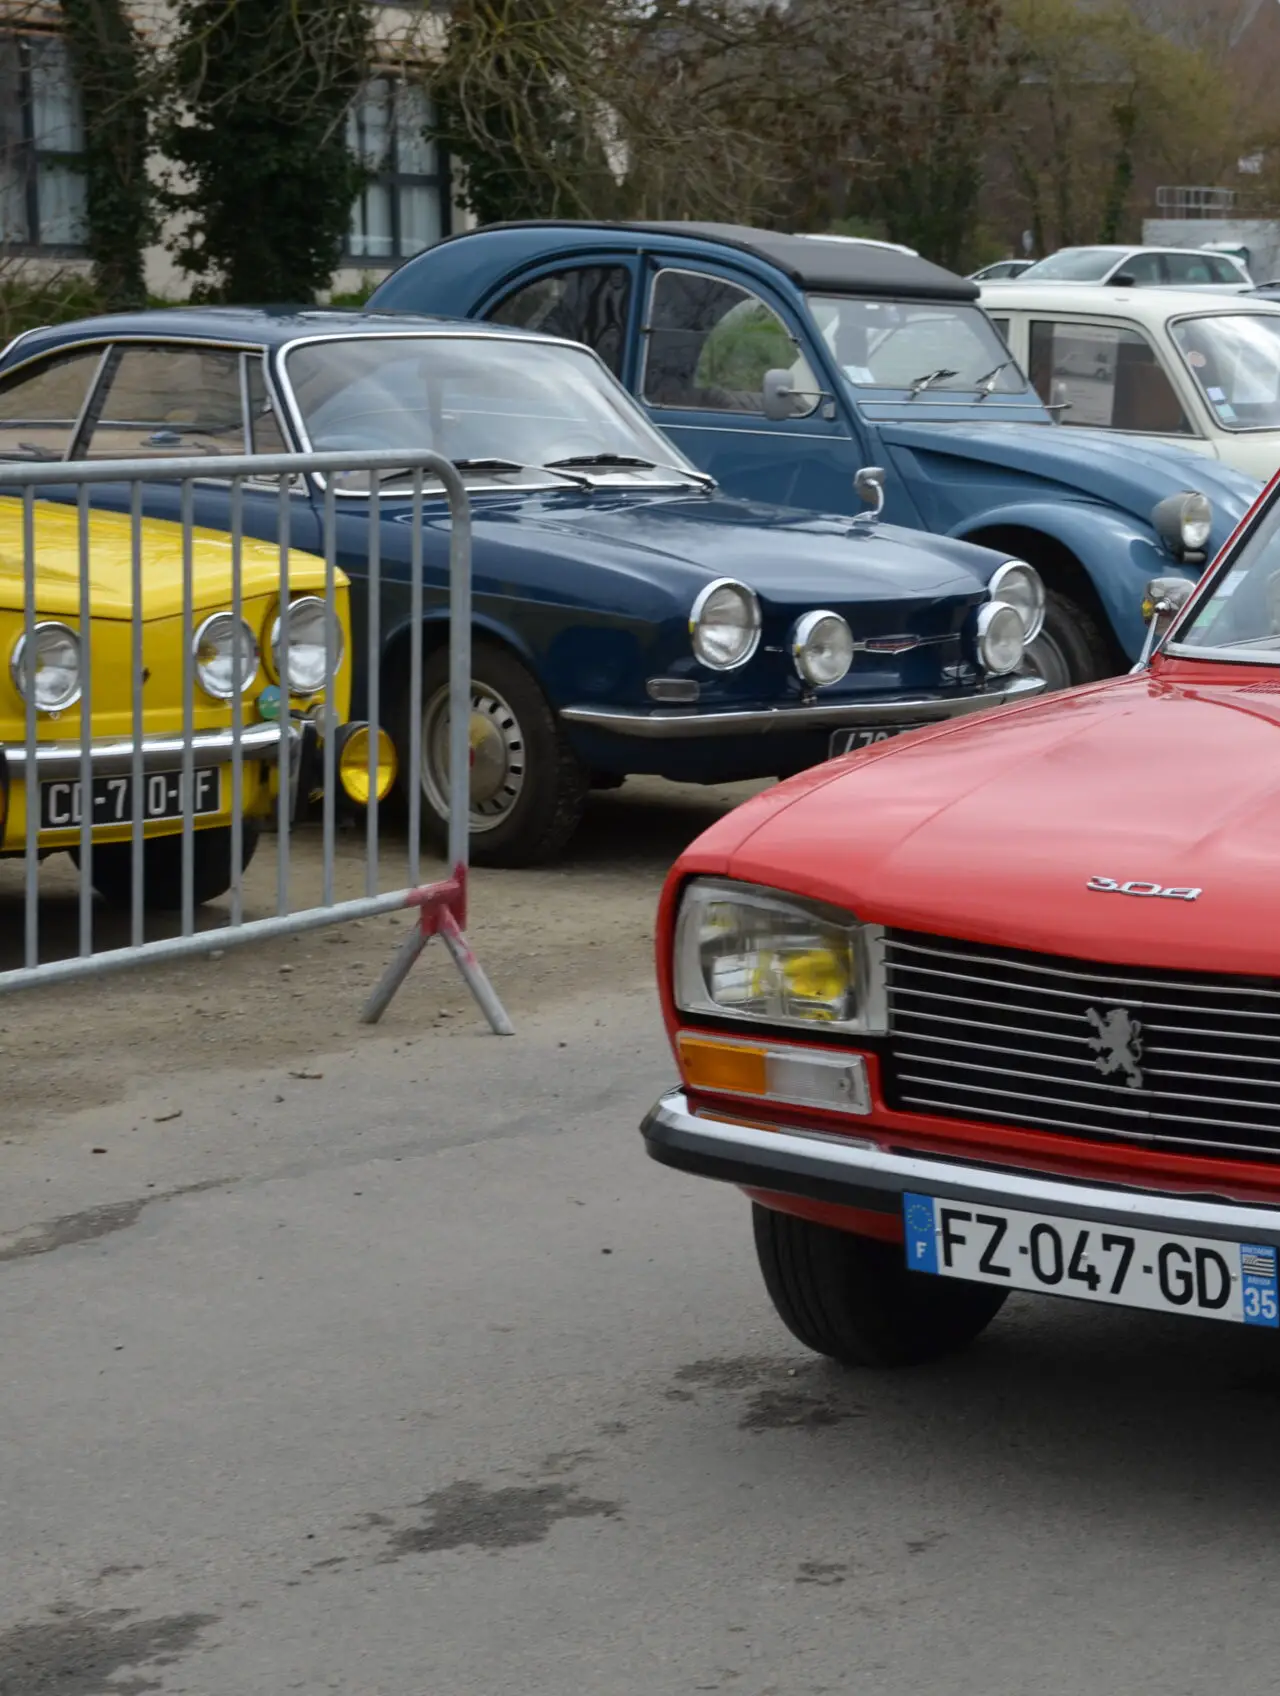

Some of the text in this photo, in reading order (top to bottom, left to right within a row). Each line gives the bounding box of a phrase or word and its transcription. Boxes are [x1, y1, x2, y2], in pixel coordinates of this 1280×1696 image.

[1086, 876, 1203, 901] 304
[916, 1241, 927, 1259] F
[1244, 1287, 1277, 1319] 35
